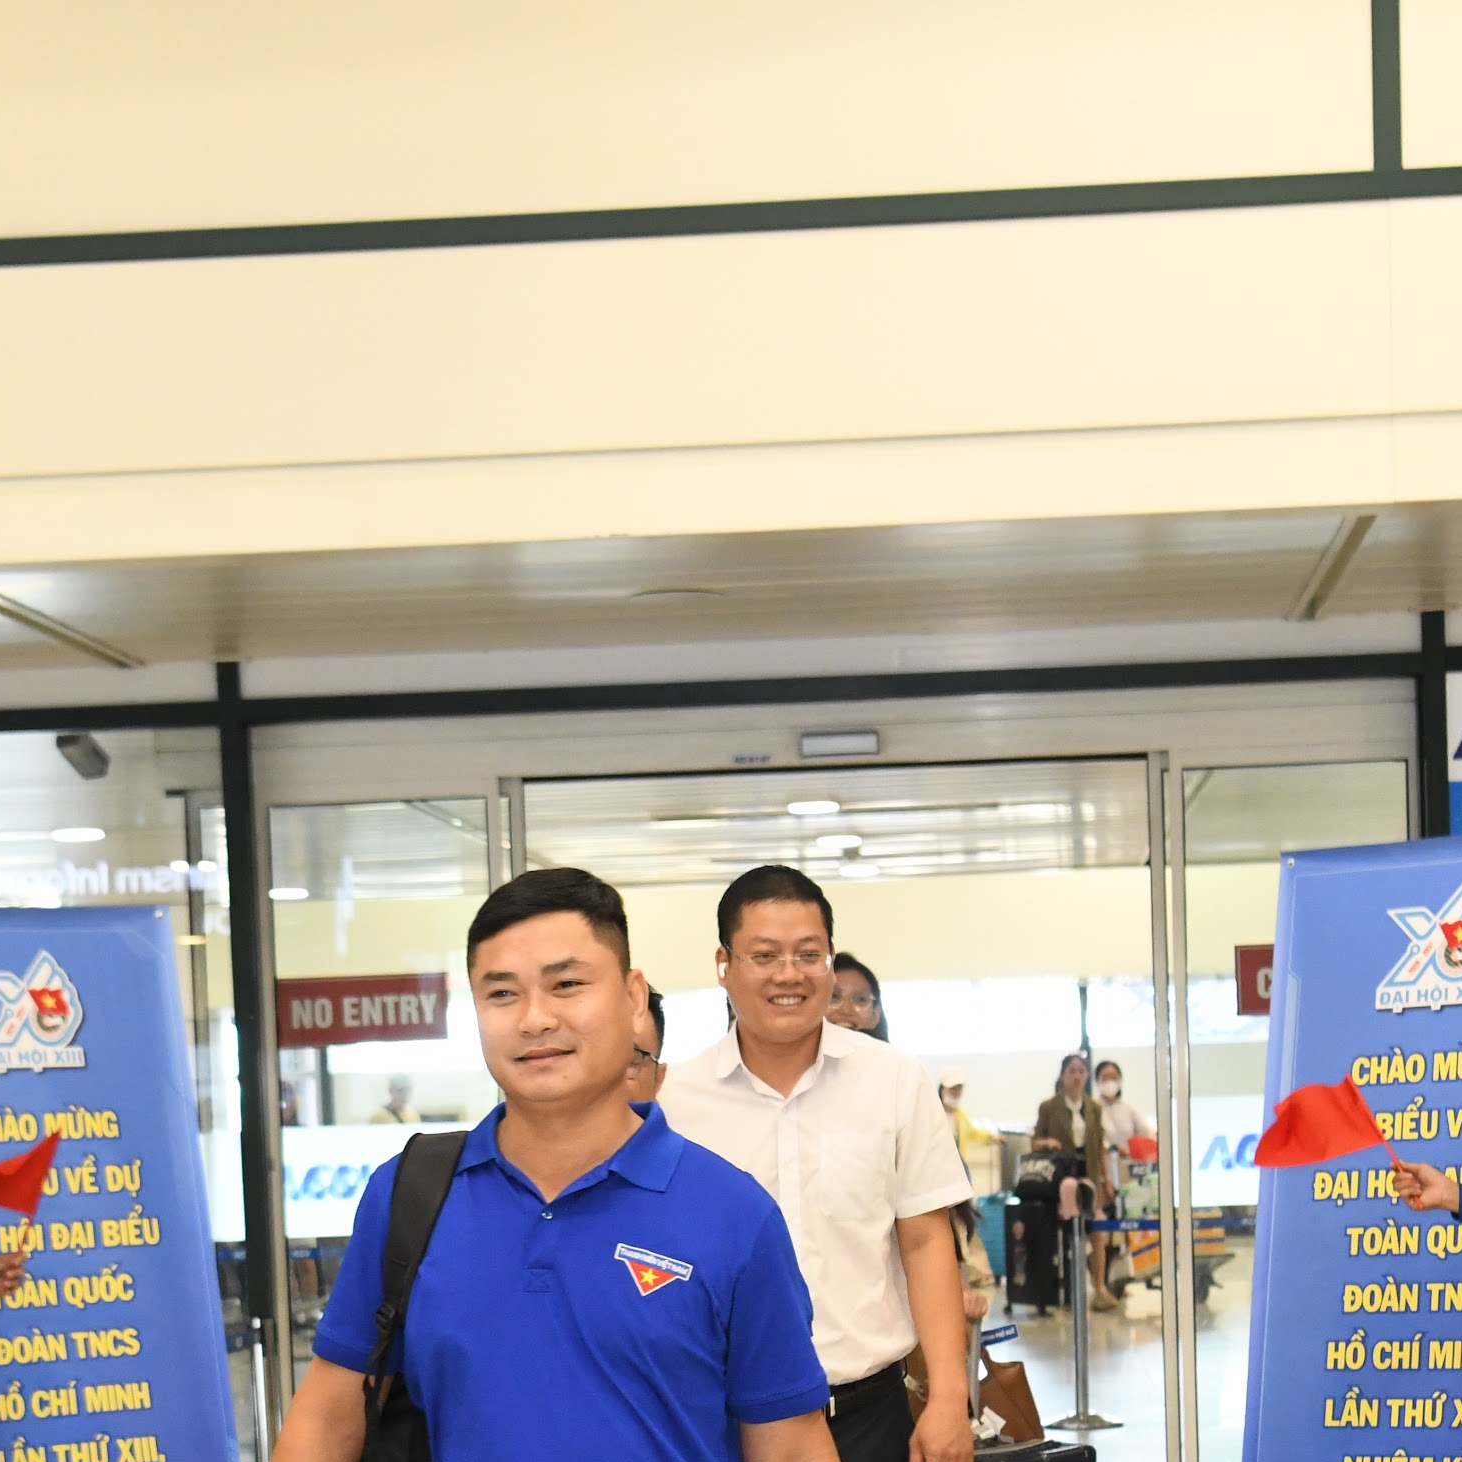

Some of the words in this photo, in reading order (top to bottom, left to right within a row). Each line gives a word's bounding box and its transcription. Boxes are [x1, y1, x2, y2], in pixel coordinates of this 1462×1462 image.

[291, 997, 334, 1030] NO
[343, 993, 437, 1028] ENTRY
[1351, 1047, 1426, 1086] CHÀO
[43, 1104, 119, 1140] MỪNG
[1375, 1096, 1439, 1141] BIỂU
[64, 1154, 99, 1194] VỀ
[105, 1159, 141, 1197] DỰ
[1313, 1170, 1360, 1207] ĐẠI
[50, 1221, 95, 1255] ĐẠI
[101, 1204, 160, 1246] BIỂU
[1346, 1218, 1419, 1256] TOÀN
[63, 1264, 135, 1309] QUỐC
[1343, 1275, 1419, 1313] ĐOÀN
[71, 1328, 140, 1358] TNCS
[1326, 1329, 1366, 1370] HỒ
[1372, 1332, 1422, 1369] CHÍ
[31, 1380, 78, 1418] CHÍ
[84, 1381, 152, 1413] MINH
[1324, 1387, 1379, 1427] LẦN
[1386, 1391, 1447, 1428] THỨ
